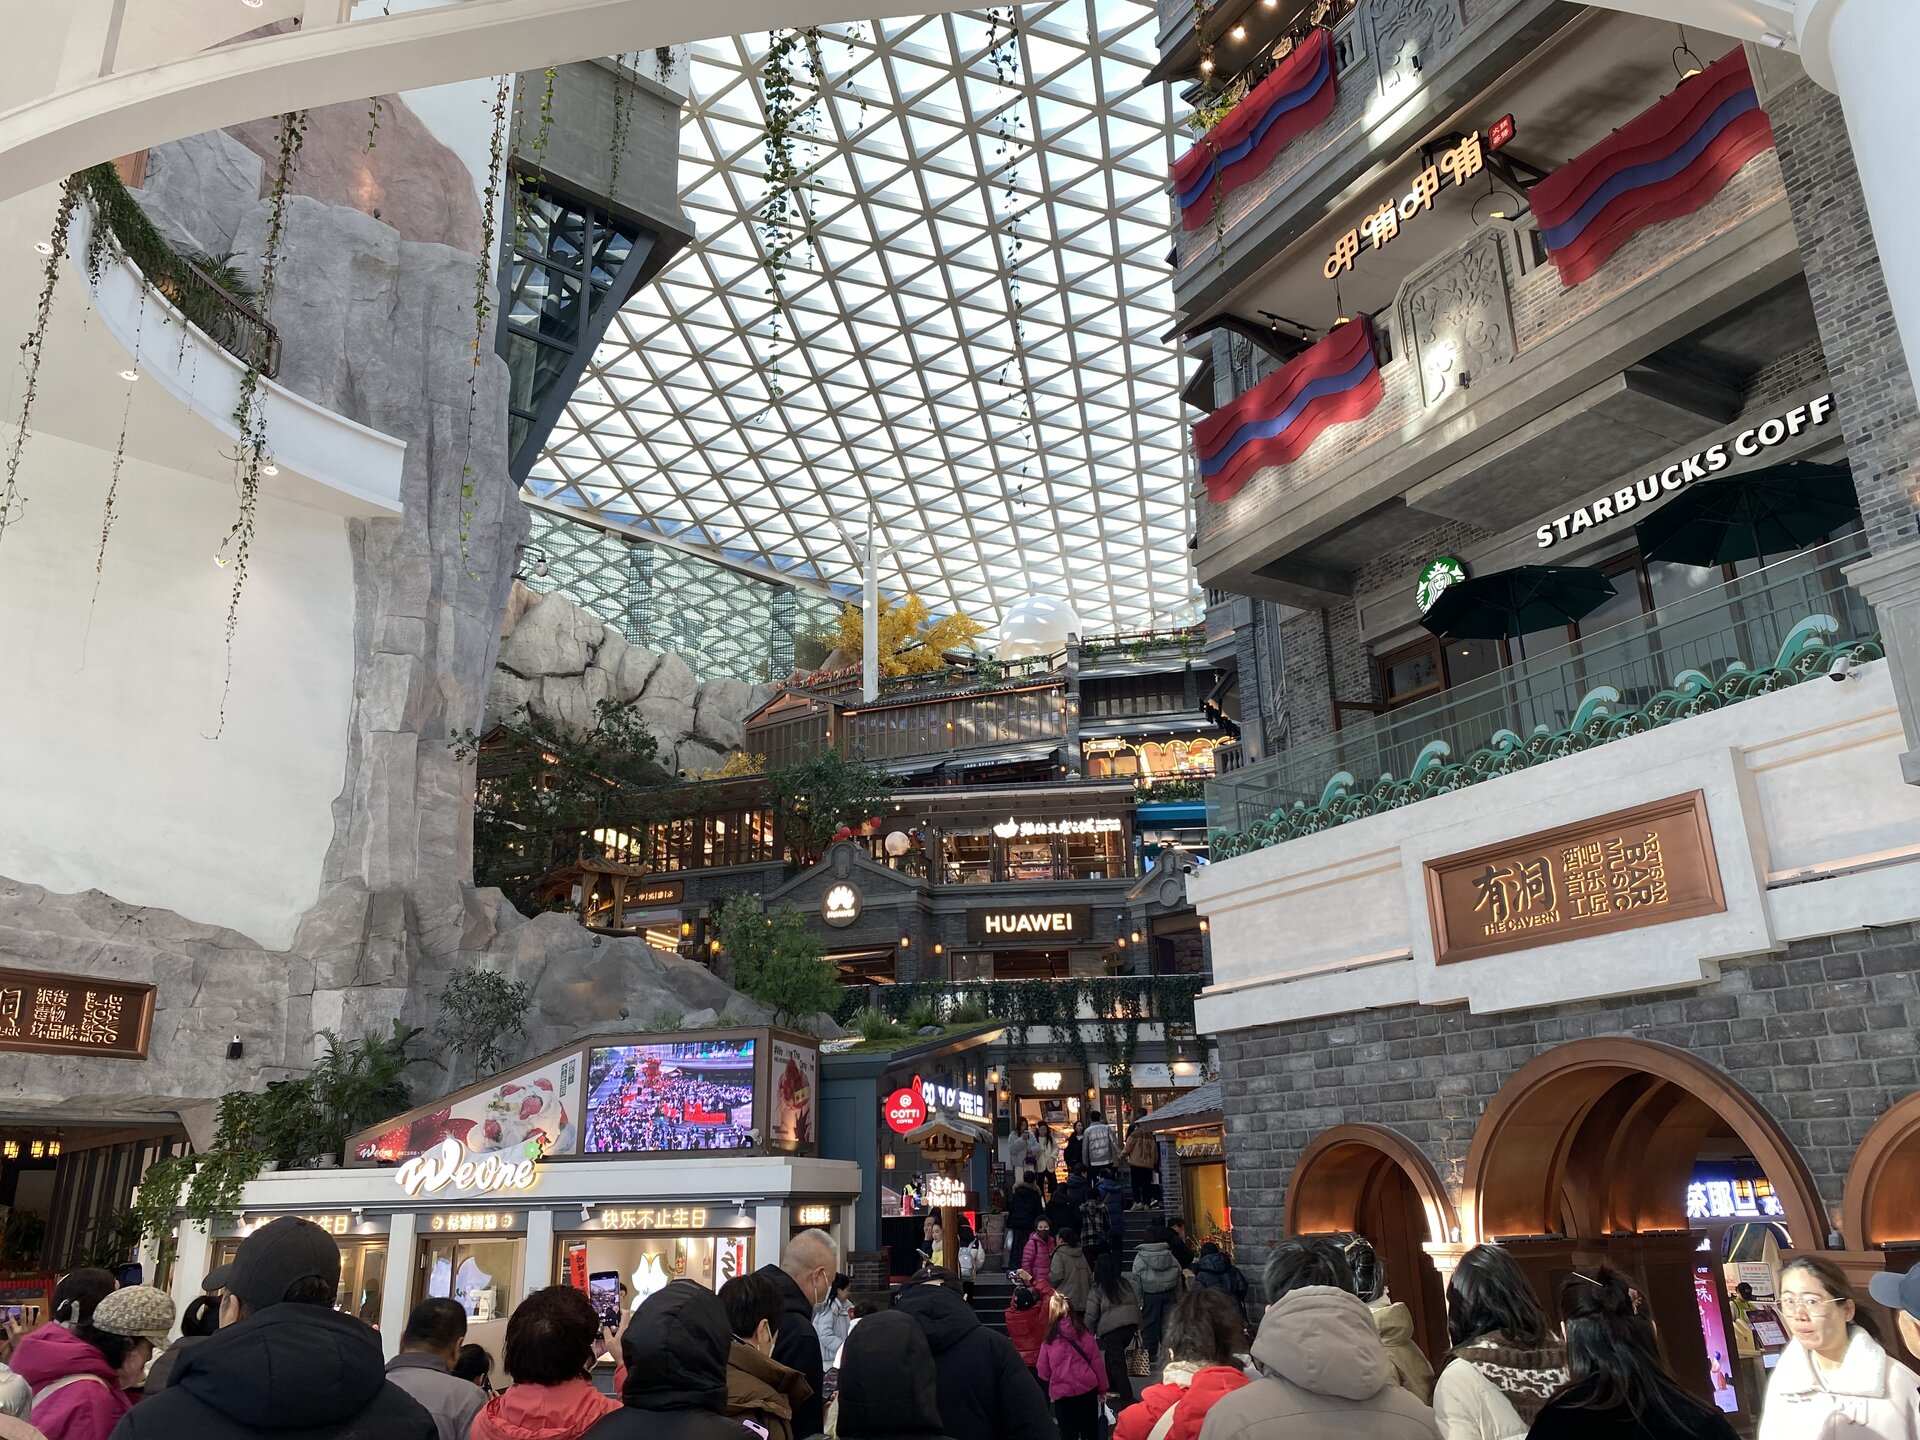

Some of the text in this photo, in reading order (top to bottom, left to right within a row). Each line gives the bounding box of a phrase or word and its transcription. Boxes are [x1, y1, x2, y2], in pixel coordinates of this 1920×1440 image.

[1324, 131, 1483, 279] 呷哺呷哺
[1536, 394, 1831, 548] STARBUCKS COFF
[1561, 841, 1604, 872] 酒吧
[1644, 832, 1668, 904] ARTISAN
[1471, 856, 1557, 922] 有洞
[1564, 866, 1607, 896] 音乐
[1605, 837, 1632, 911] MUSIC
[1622, 842, 1654, 908] BAR
[827, 908, 855, 918] HUAWEI
[1569, 891, 1611, 919] 工匠
[985, 913, 1073, 933] HUAWEI
[1482, 910, 1561, 936] THE CAVERN
[104, 994, 123, 1044] BRAVO
[890, 1109, 920, 1119] COTTI
[602, 1209, 706, 1230] 快乐不止生日
